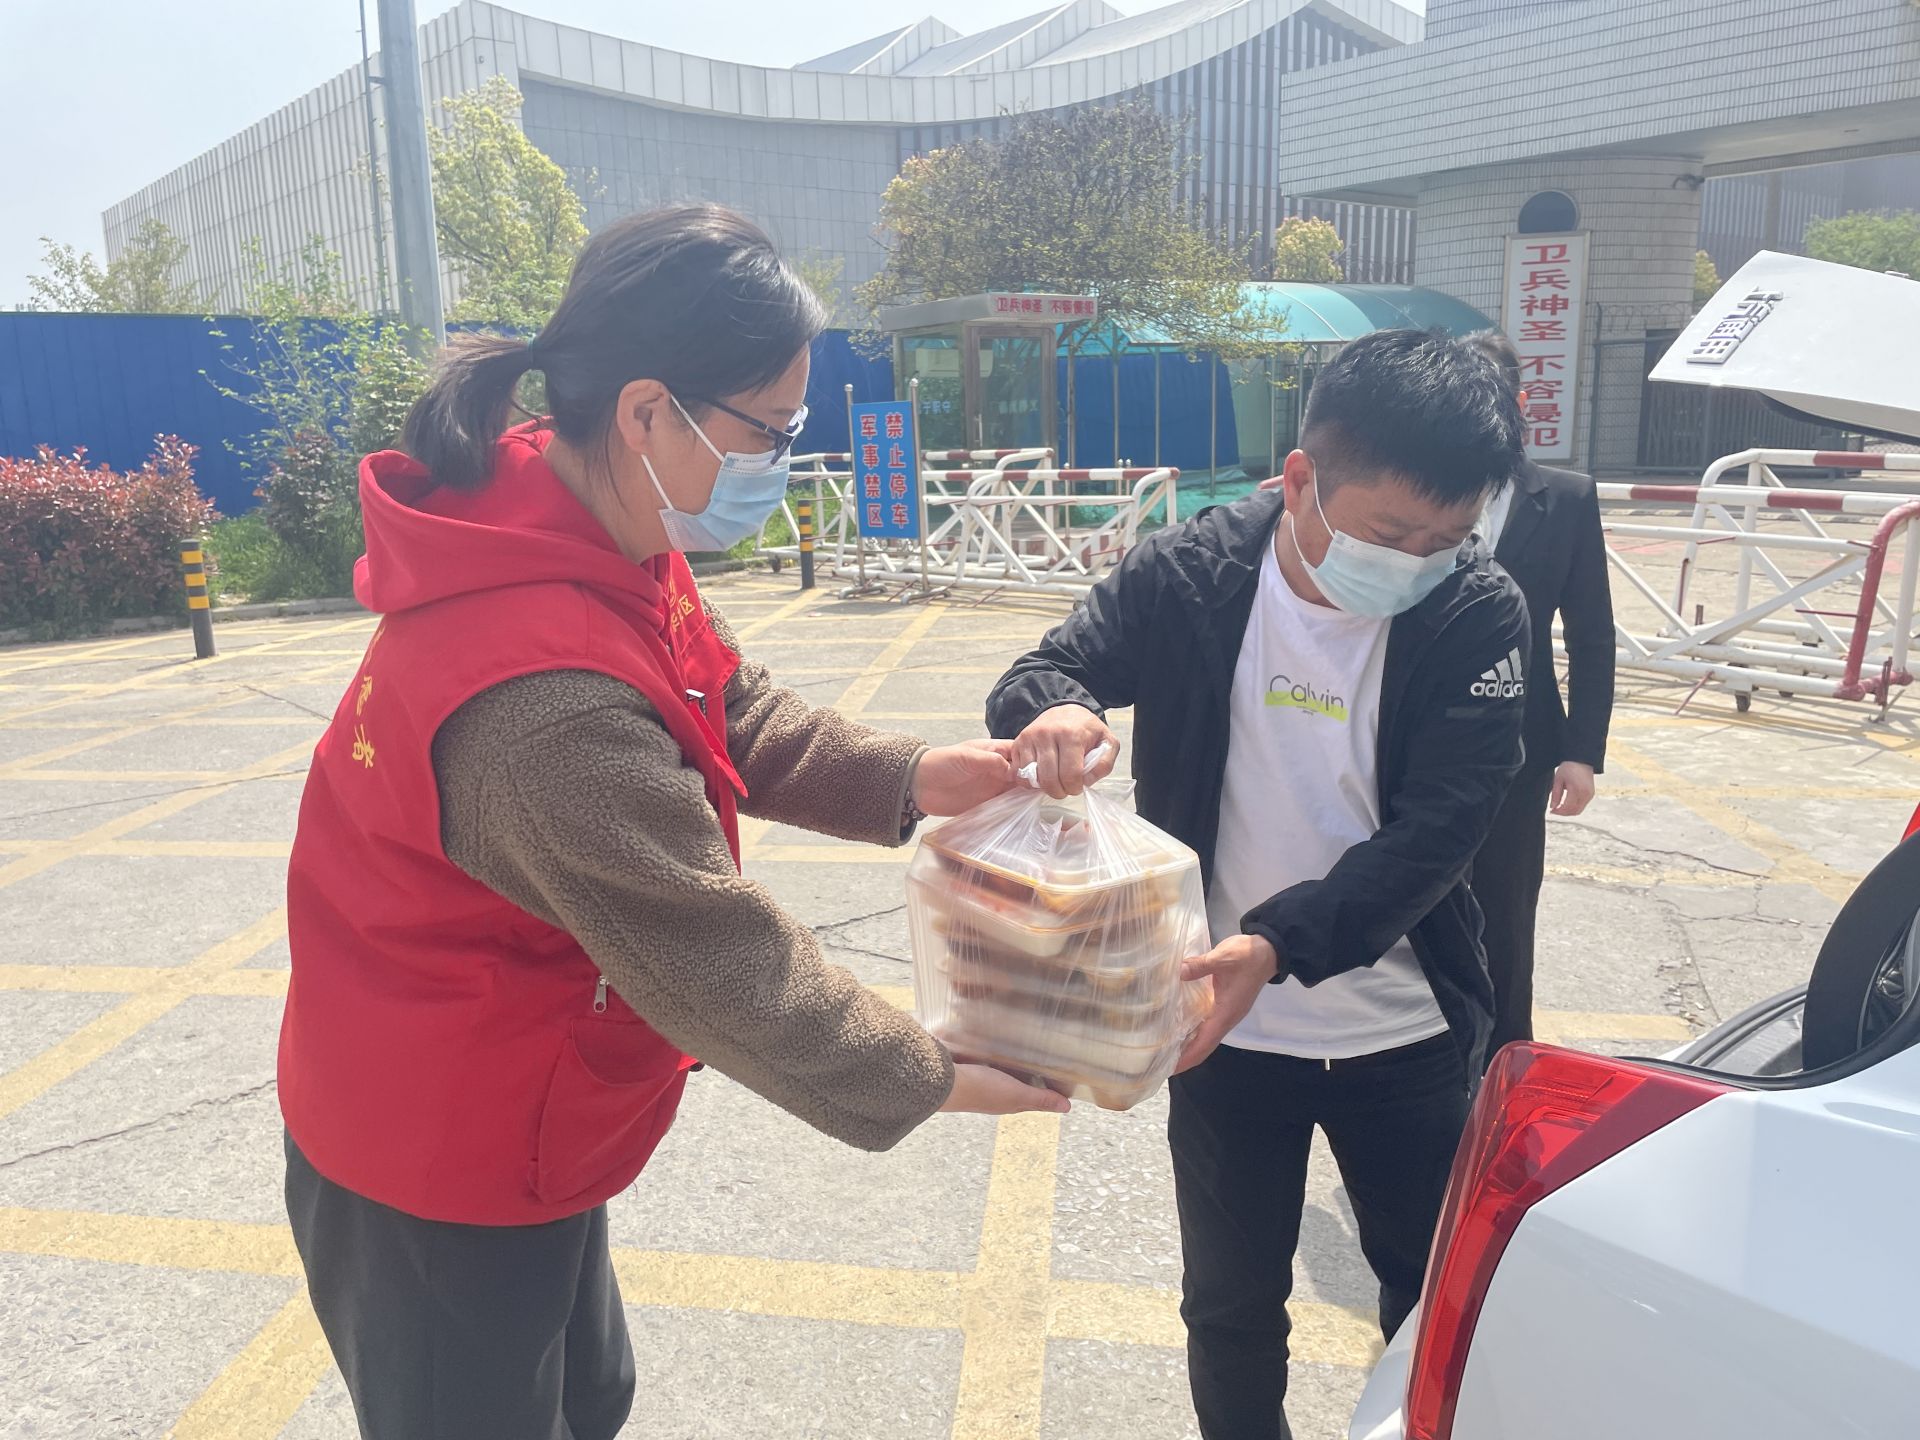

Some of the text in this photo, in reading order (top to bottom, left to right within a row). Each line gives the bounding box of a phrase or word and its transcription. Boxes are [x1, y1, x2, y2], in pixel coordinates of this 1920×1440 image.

[1518, 243, 1571, 342] 卫兵神圣
[860, 413, 884, 528] 军事禁区
[885, 411, 909, 530] 禁止停车
[1268, 674, 1344, 712] Calvin
